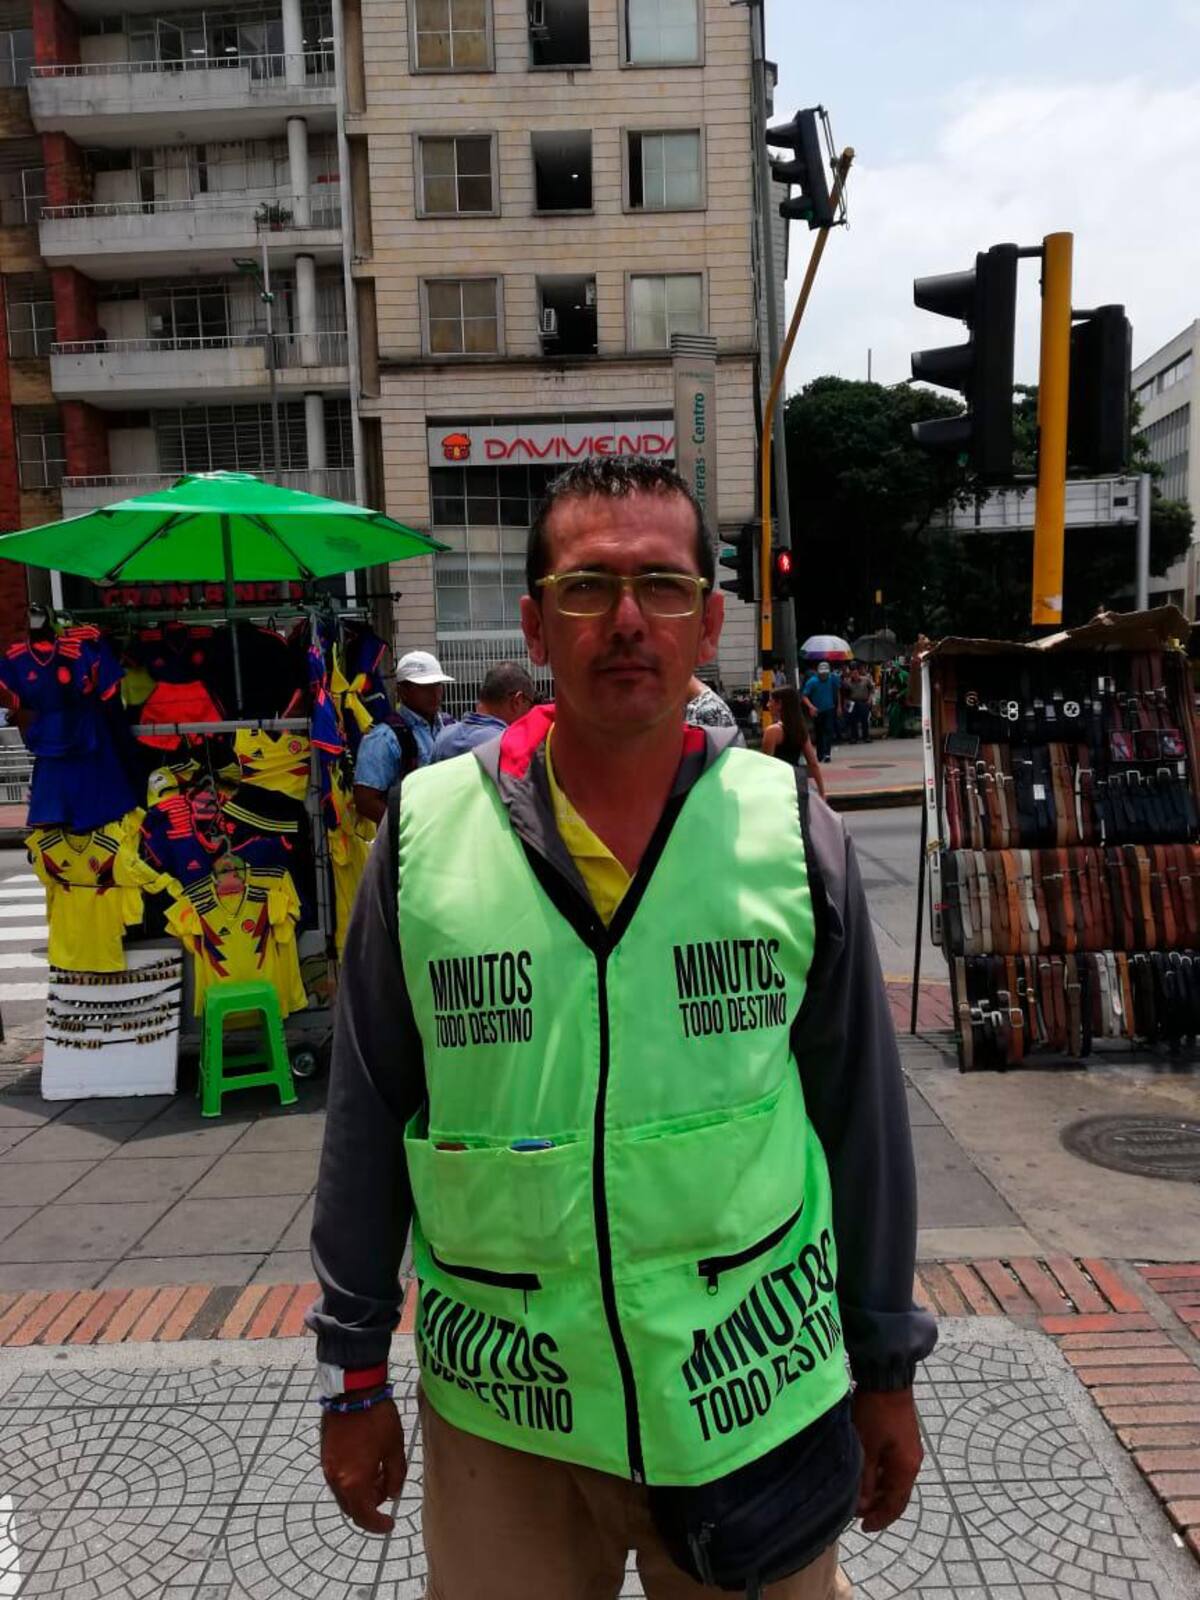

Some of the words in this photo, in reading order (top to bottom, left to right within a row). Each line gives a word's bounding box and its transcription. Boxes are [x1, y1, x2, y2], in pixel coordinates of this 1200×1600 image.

[692, 392, 705, 444] Centro
[428, 950, 533, 1012] MINUTOS
[673, 938, 786, 1000] MINUTOS
[434, 1012, 468, 1049] TODO
[469, 1007, 533, 1045] DESTINO
[679, 999, 725, 1038] TODO
[727, 992, 788, 1033] DESTINO
[689, 1368, 771, 1441] TODO
